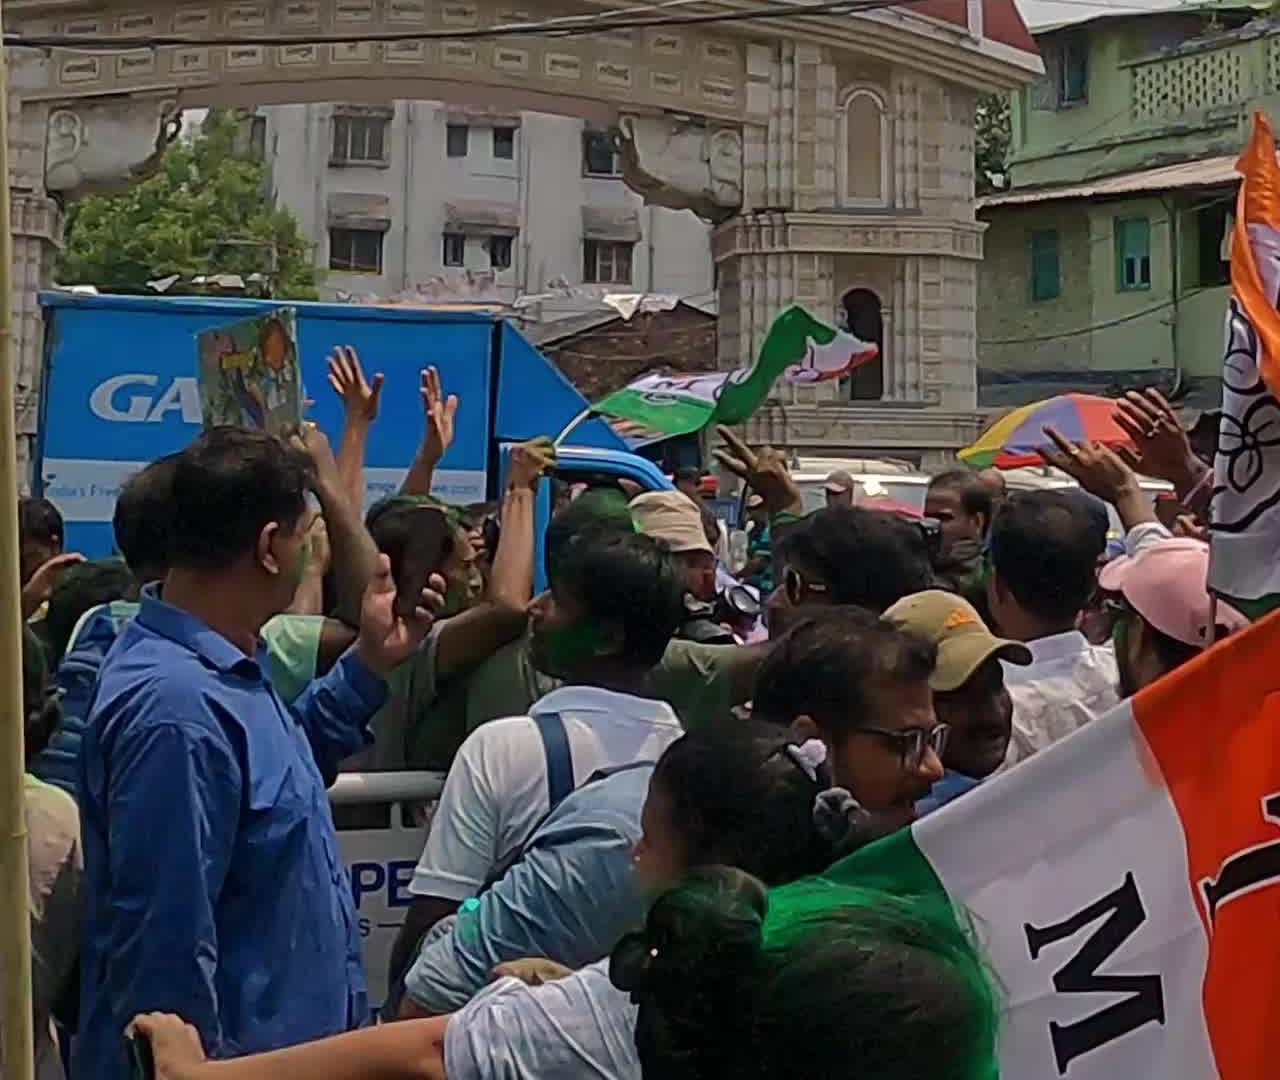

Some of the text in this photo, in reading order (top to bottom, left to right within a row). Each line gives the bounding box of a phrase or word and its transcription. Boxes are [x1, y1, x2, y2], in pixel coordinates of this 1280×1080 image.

[89, 373, 204, 424] GA
[352, 860, 418, 910] PE
[1025, 871, 1166, 1076] M
